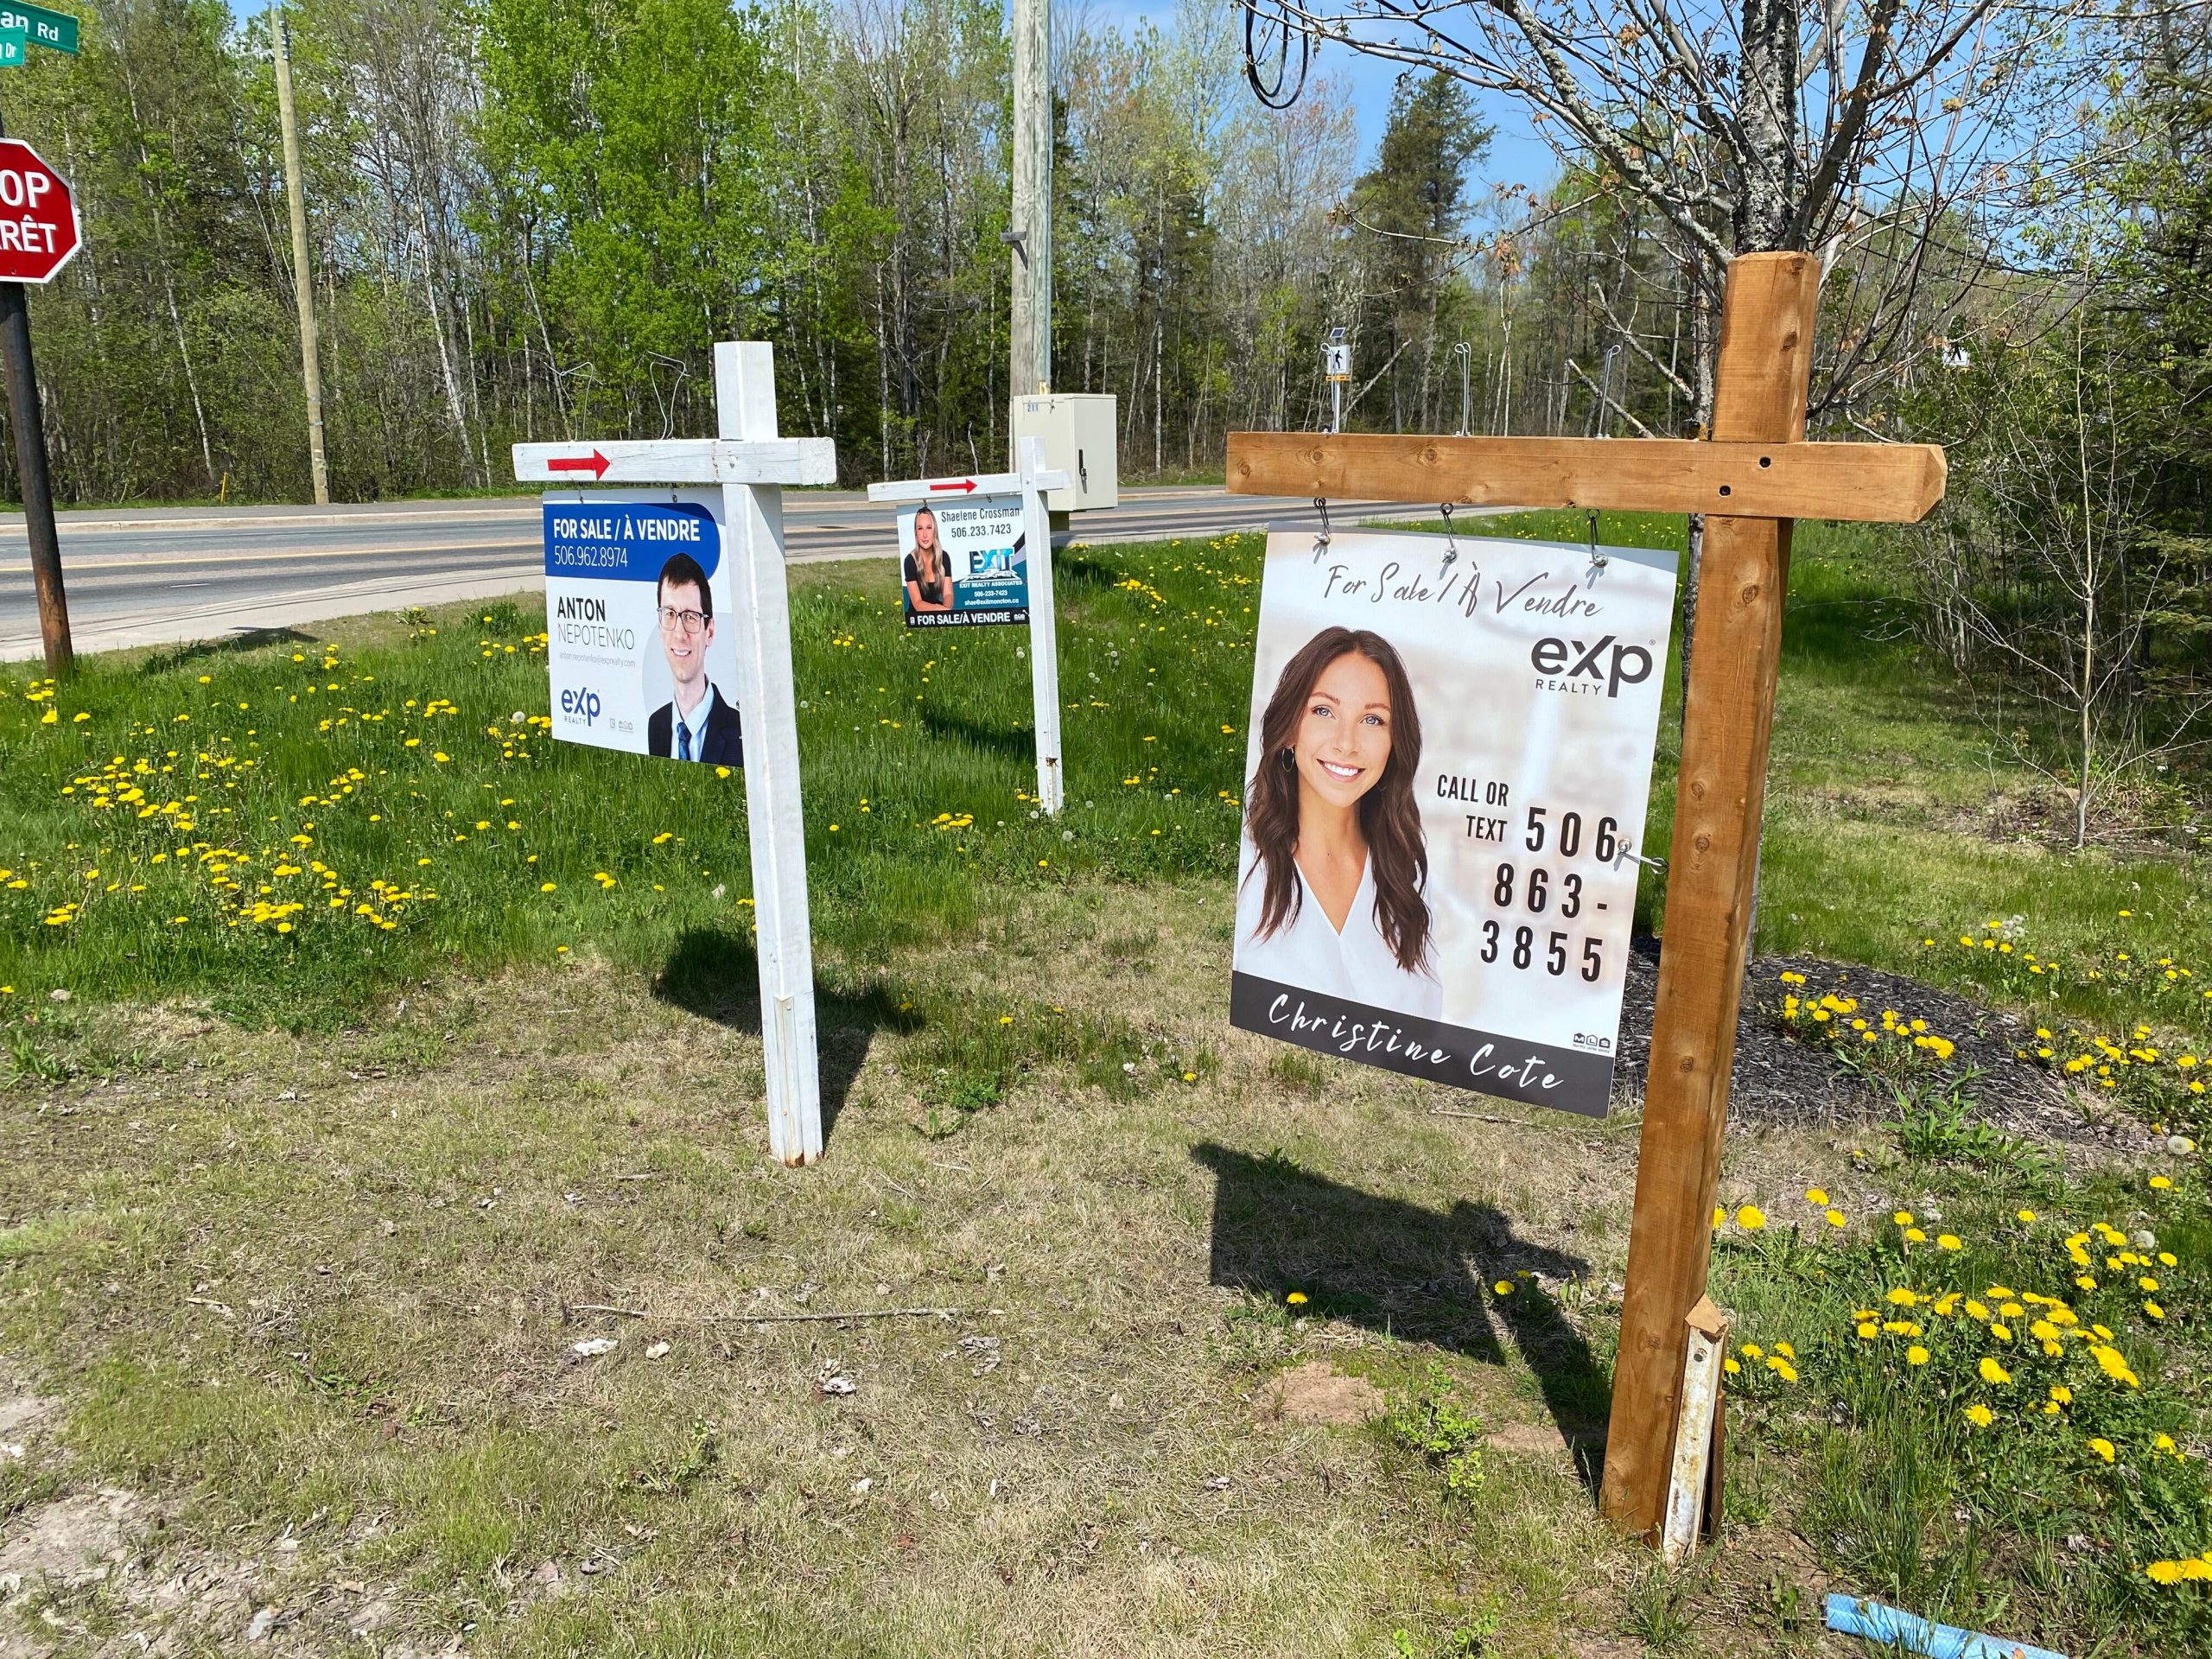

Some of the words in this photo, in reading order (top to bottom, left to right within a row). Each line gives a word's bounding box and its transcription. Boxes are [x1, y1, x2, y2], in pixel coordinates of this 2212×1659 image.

[37, 22, 59, 41] Rd
[5, 41, 16, 59] Dr
[0, 214, 56, 253] RÊT
[1027, 404, 1039, 412] 211
[553, 518, 577, 538] FOR
[580, 521, 613, 540] SALE
[614, 521, 620, 541] /
[623, 513, 635, 541] À
[637, 518, 701, 542] VENDRE
[941, 511, 977, 523] Shaelene
[979, 507, 1020, 518] Crossman
[951, 524, 1012, 537] 506.233.7423
[554, 545, 628, 568] 506.962.8974
[1324, 565, 1367, 599] For
[1370, 562, 1434, 603] Sale
[1438, 573, 1459, 603] /
[1496, 572, 1602, 618] Vendre
[556, 595, 606, 622] ANTON
[917, 614, 936, 626] FOR
[937, 611, 970, 624] SALE/À
[970, 612, 1011, 624] VENDRE
[557, 623, 635, 650] NEPOTENKO
[1535, 678, 1602, 696] REALTY
[564, 715, 587, 726] REALTY
[1437, 774, 1479, 803] CALL
[1485, 781, 1510, 807] OR
[1466, 814, 1508, 842] TEXT
[1525, 805, 1618, 863] 506
[1480, 919, 1604, 983] 3855
[1268, 993, 1452, 1065] Christine
[1470, 1043, 1565, 1090] Cote
